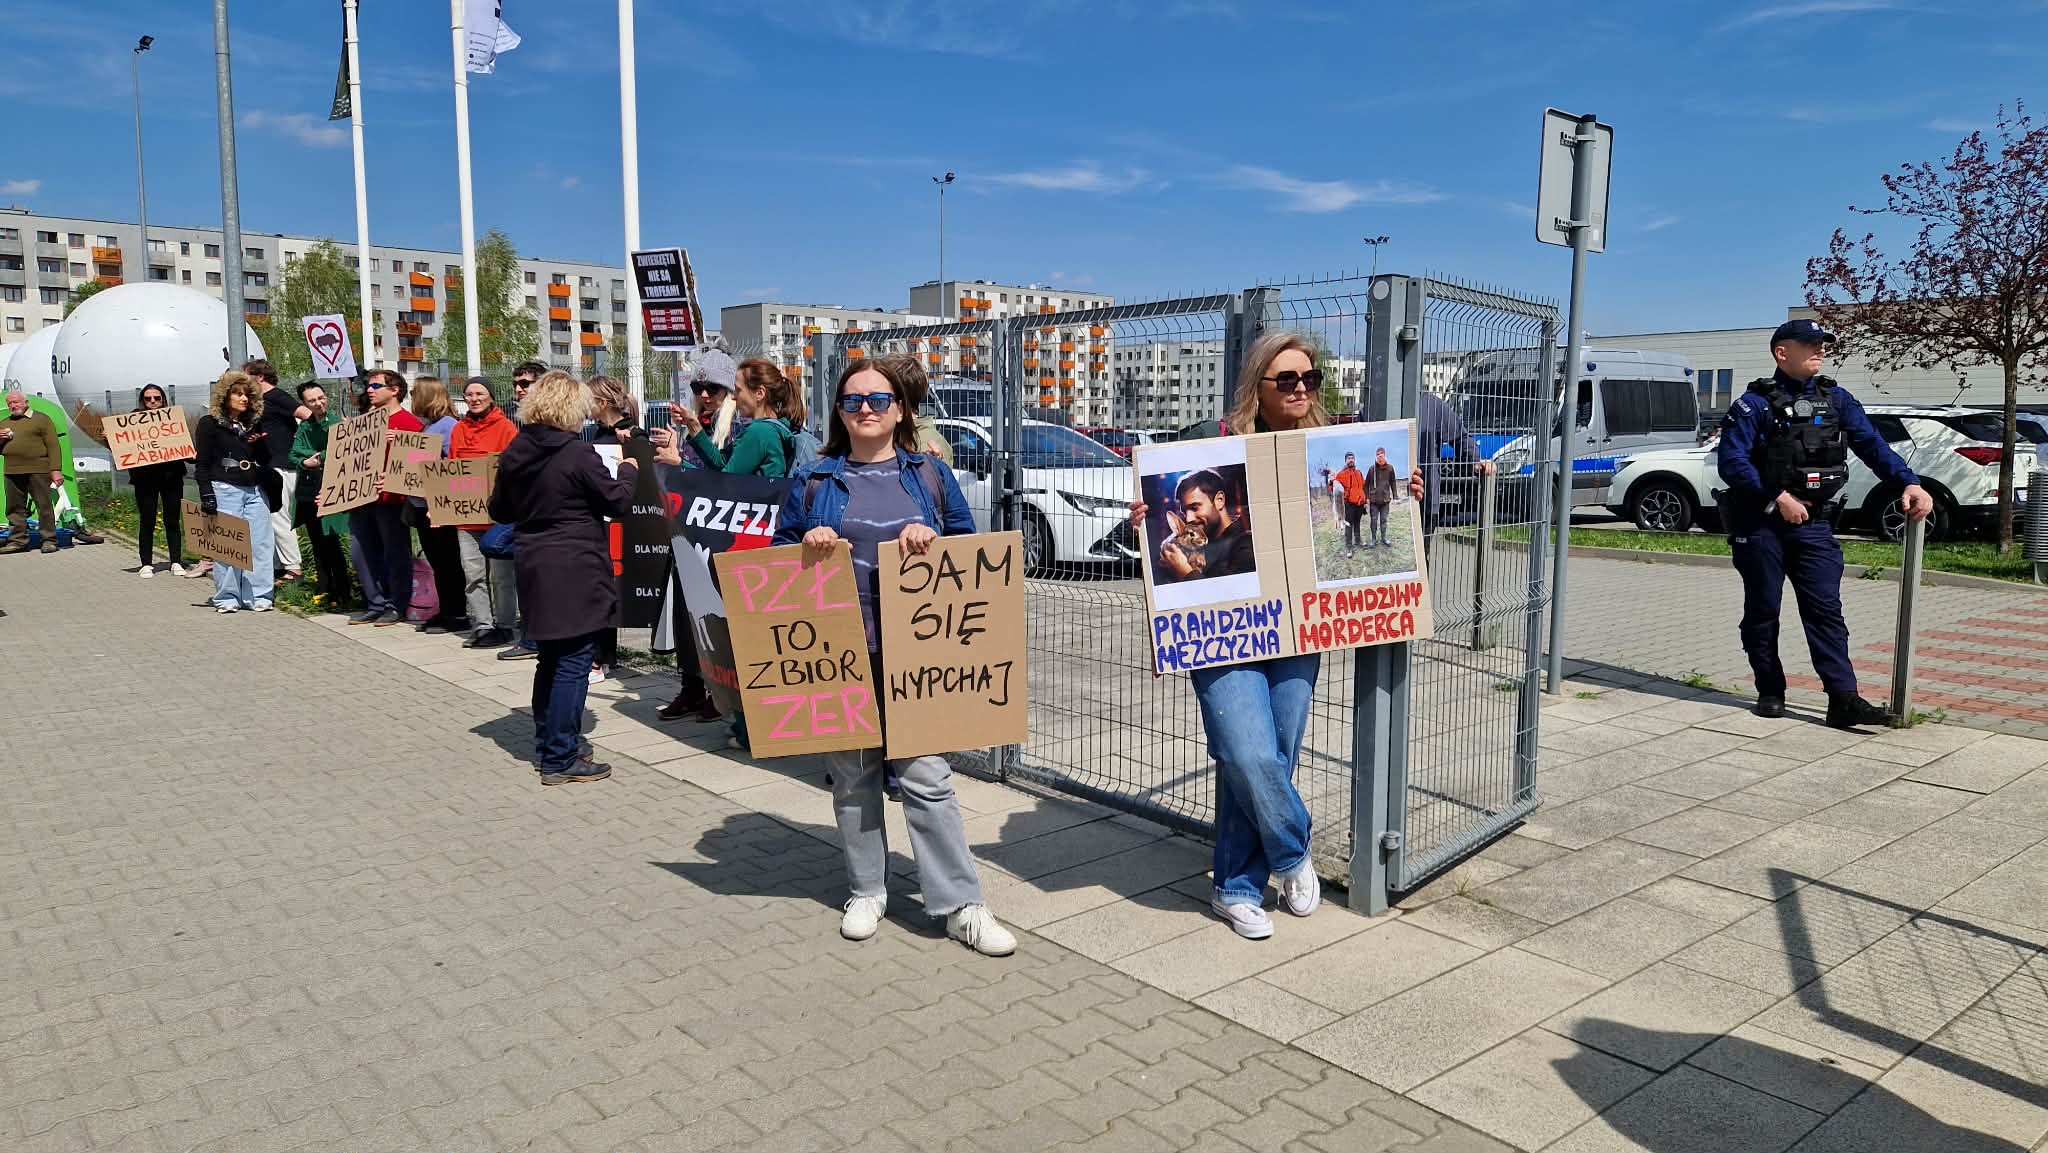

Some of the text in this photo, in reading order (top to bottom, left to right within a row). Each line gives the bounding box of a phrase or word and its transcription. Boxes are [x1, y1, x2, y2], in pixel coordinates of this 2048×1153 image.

[647, 269, 671, 283] NIE SĄ
[643, 284, 680, 298] TROFEAMI
[51, 354, 70, 380] a.pl
[116, 408, 171, 428] UCZMY
[335, 407, 387, 441] BOHATER
[115, 421, 185, 444] MIŁOŚCI
[393, 433, 429, 450] MACIE
[120, 444, 196, 467] ZABIJANIA
[136, 440, 160, 450] NIE
[335, 431, 381, 460] CHRONI
[337, 451, 371, 479] A NIE
[389, 460, 404, 475] NA
[424, 460, 473, 478] MACIE
[434, 495, 451, 510] NA
[453, 498, 488, 518] RĘKA
[632, 504, 647, 514] DLA
[685, 496, 780, 537] RZEZI
[190, 527, 204, 537] OD
[207, 524, 245, 541] WOLNE
[634, 544, 651, 554] DLA
[899, 545, 1012, 595] SAM
[635, 587, 653, 597] DLA
[730, 559, 857, 613] PZŁ
[1301, 581, 1423, 621] PRAWDZIWY
[910, 601, 989, 645] SIĘ
[1153, 599, 1283, 647] PRAWDZIWY
[1299, 609, 1415, 653] MORDERCA
[745, 641, 863, 690] ZBIÓR
[890, 660, 1013, 706] WYPCHAJ
[760, 687, 877, 739] ZER
